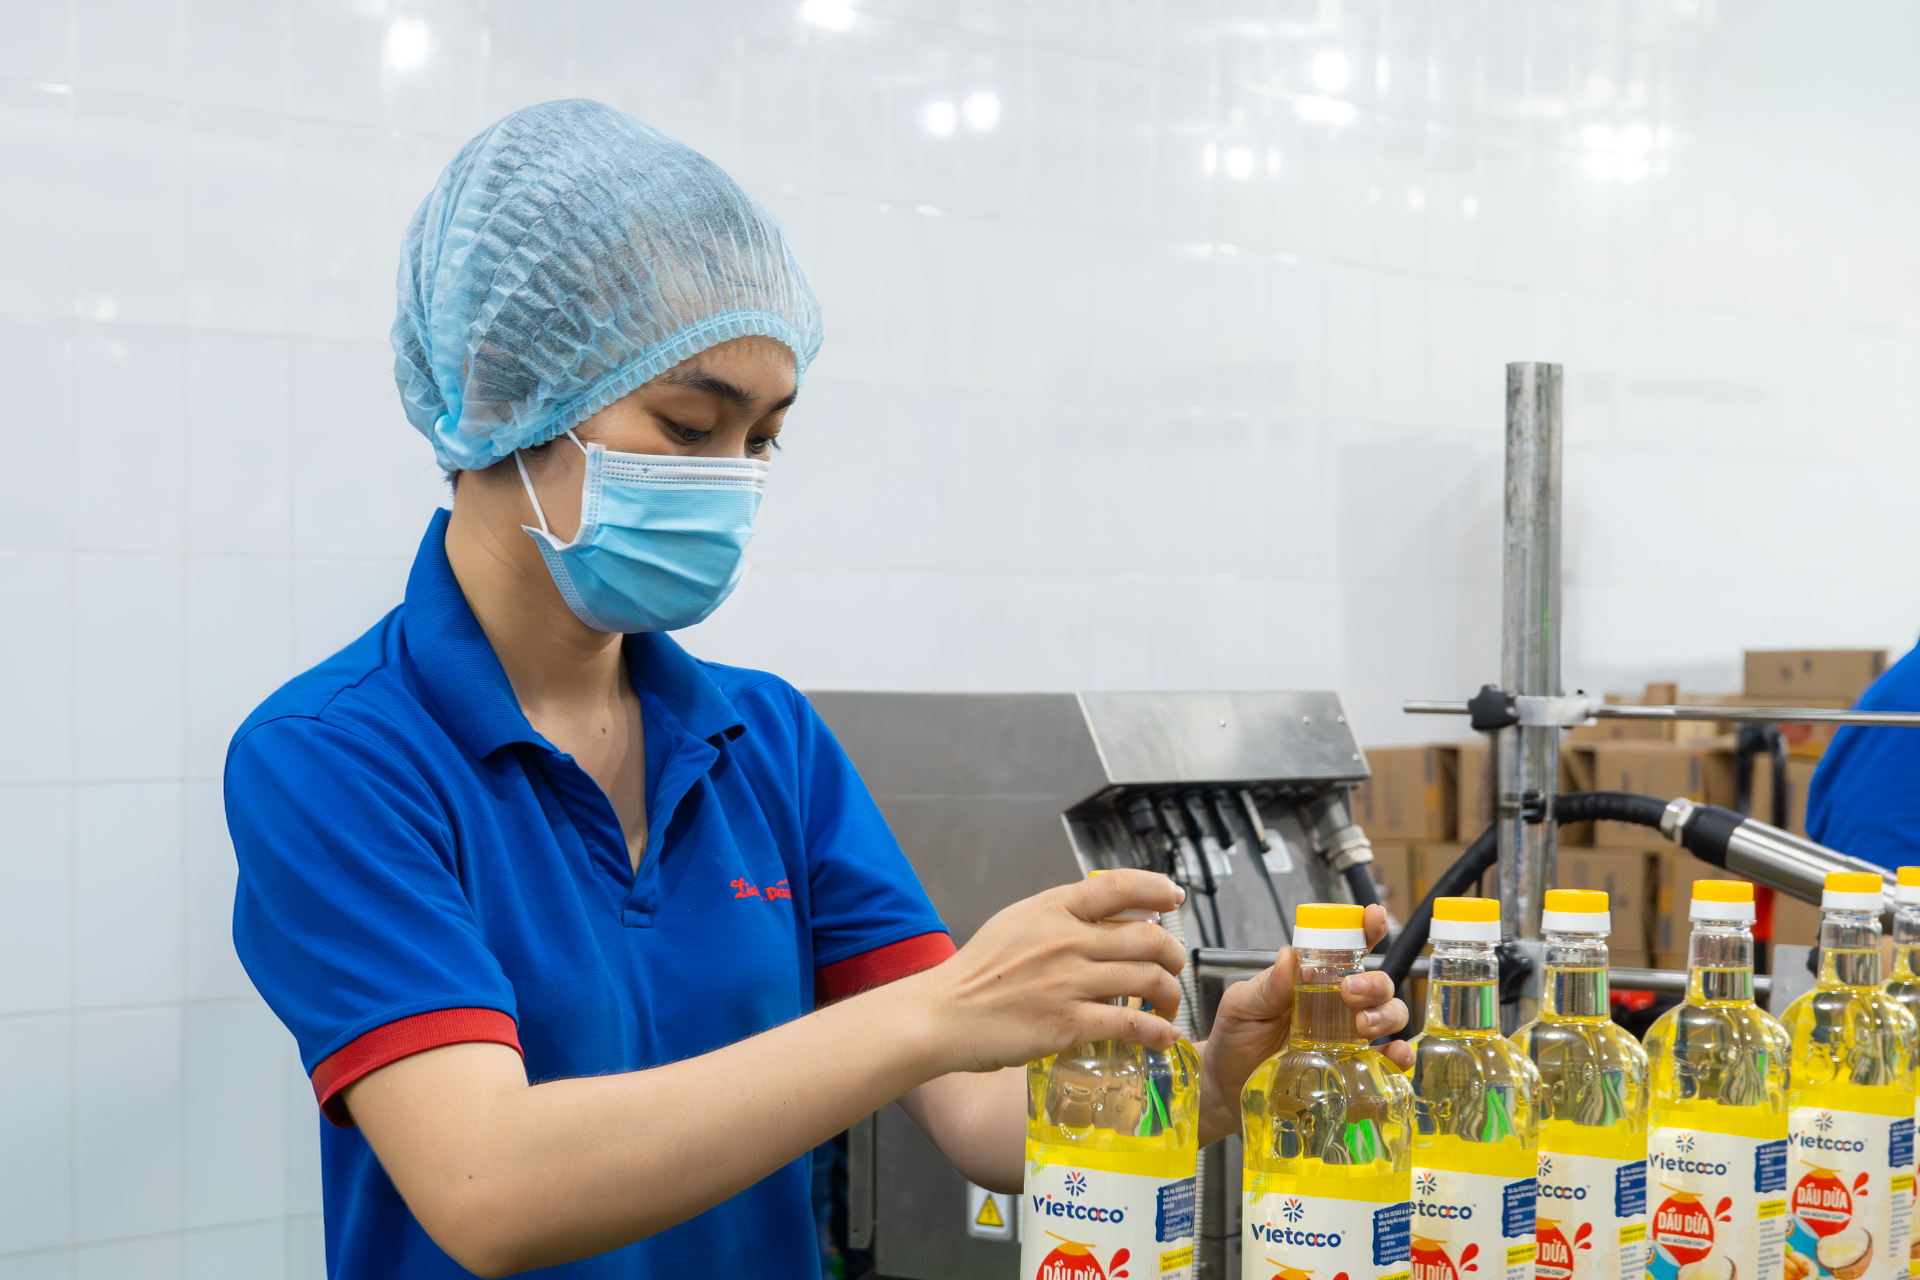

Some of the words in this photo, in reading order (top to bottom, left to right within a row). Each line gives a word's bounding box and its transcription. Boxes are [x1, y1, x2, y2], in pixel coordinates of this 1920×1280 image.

[1788, 1130, 1865, 1152] Vietcoco
[1649, 1151, 1727, 1175] Vietcoco
[1536, 1181, 1586, 1200] tcoco
[1797, 1182, 1821, 1206] DẦU
[1822, 1186, 1848, 1209] DỪA
[1033, 1194, 1124, 1223] Vietcoco
[1409, 1199, 1472, 1220] etcoco
[1657, 1207, 1683, 1232] DẦU
[1684, 1211, 1710, 1235] DỪA
[1251, 1221, 1341, 1248] Vietcoco
[1542, 1238, 1569, 1264] DỪA
